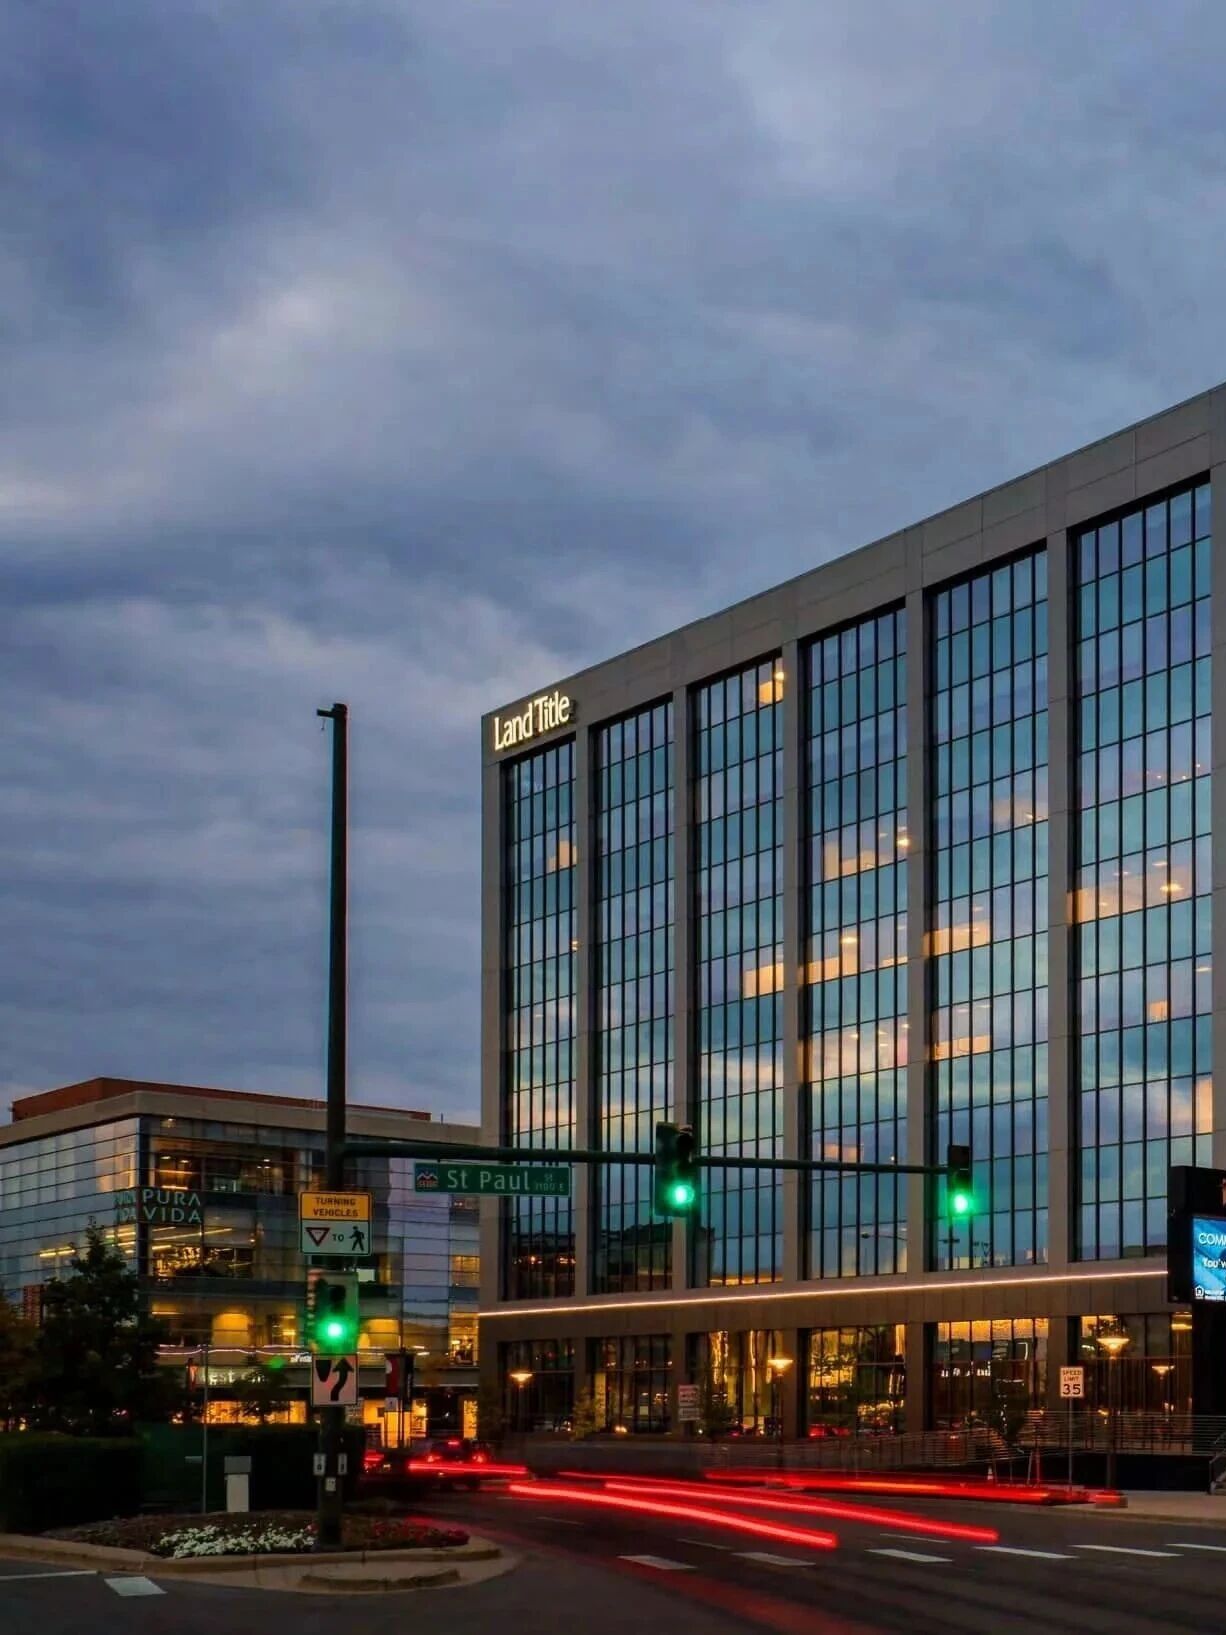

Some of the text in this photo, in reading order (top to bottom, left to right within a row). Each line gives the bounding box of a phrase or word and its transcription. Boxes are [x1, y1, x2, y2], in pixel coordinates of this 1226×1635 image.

[494, 690, 570, 751] Land Title
[447, 1169, 531, 1191] St Paul
[143, 1188, 201, 1207] PURA
[315, 1196, 356, 1206] TURNING
[143, 1206, 202, 1223] VIDA
[313, 1208, 359, 1217] VEHICLES
[332, 1233, 345, 1242] TO
[1062, 1383, 1081, 1395] 35
